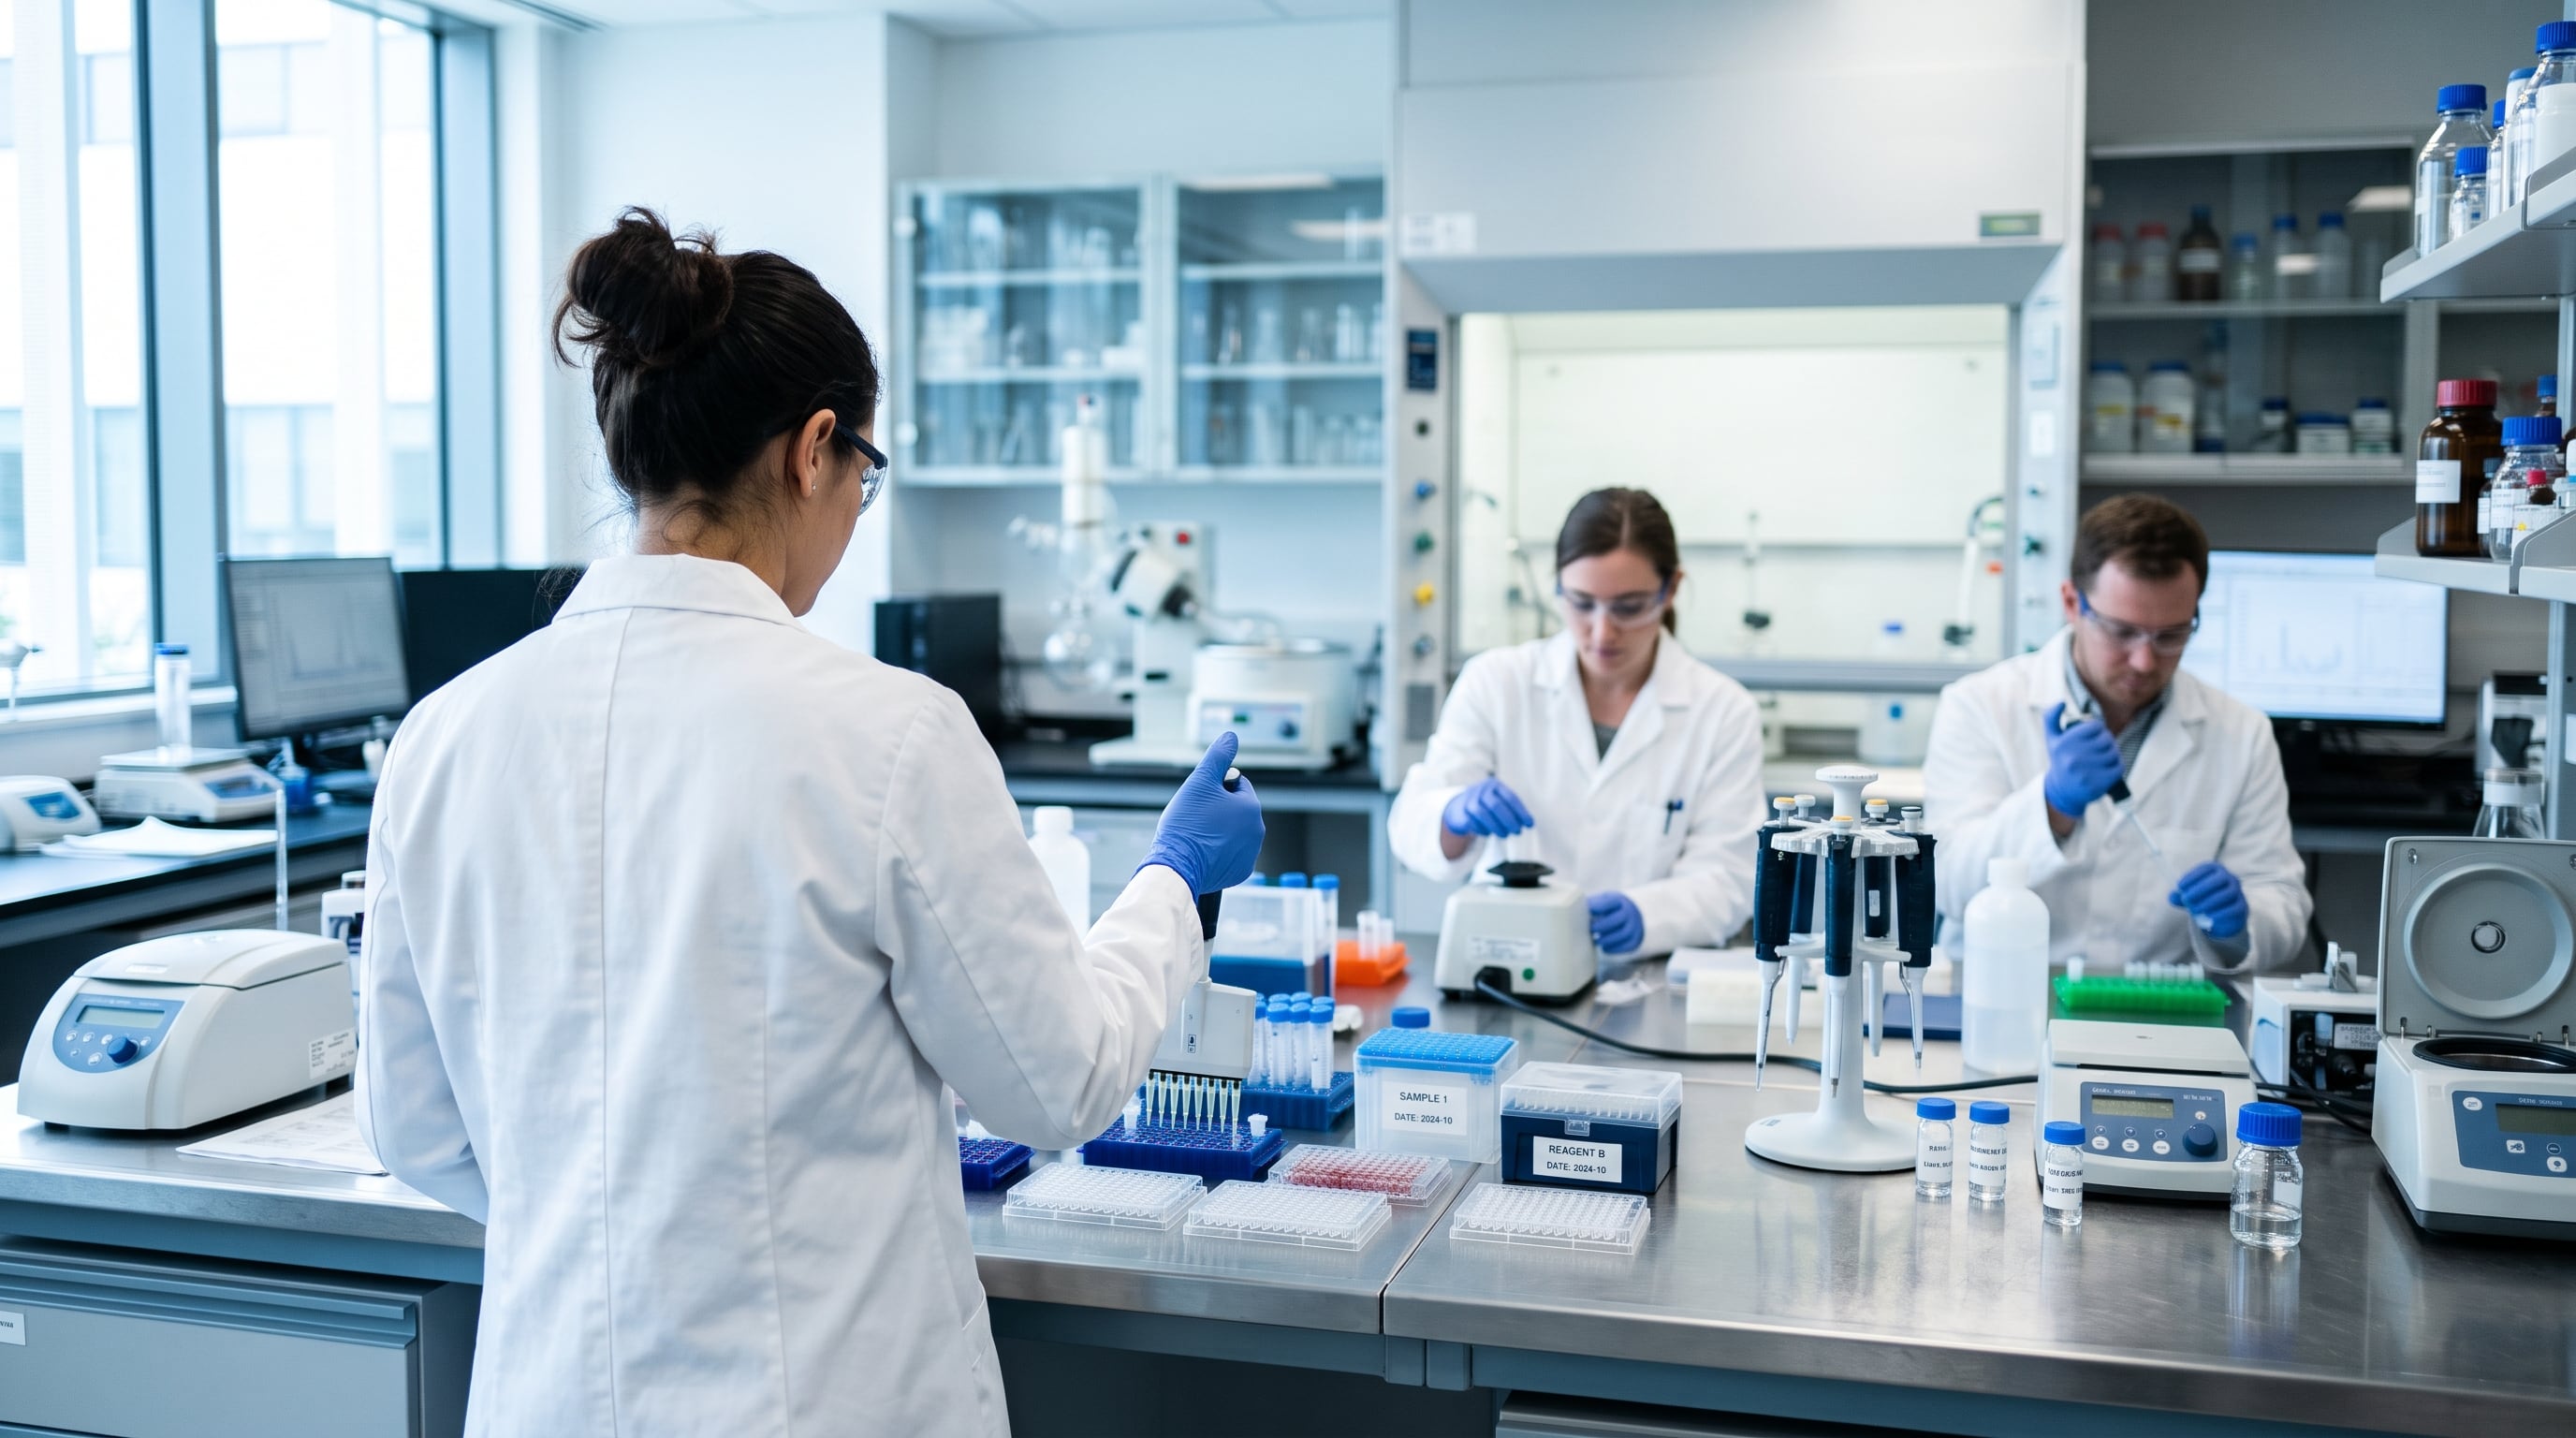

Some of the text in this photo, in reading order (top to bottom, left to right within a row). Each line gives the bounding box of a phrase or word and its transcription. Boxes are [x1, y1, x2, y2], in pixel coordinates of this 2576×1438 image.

[1399, 1092, 1447, 1104] SAMPLE 1
[1394, 1112, 1453, 1124] DATE: 2024-10
[1548, 1145, 1605, 1158] REAGENT B
[1546, 1161, 1606, 1174] DATE: 2024-10
